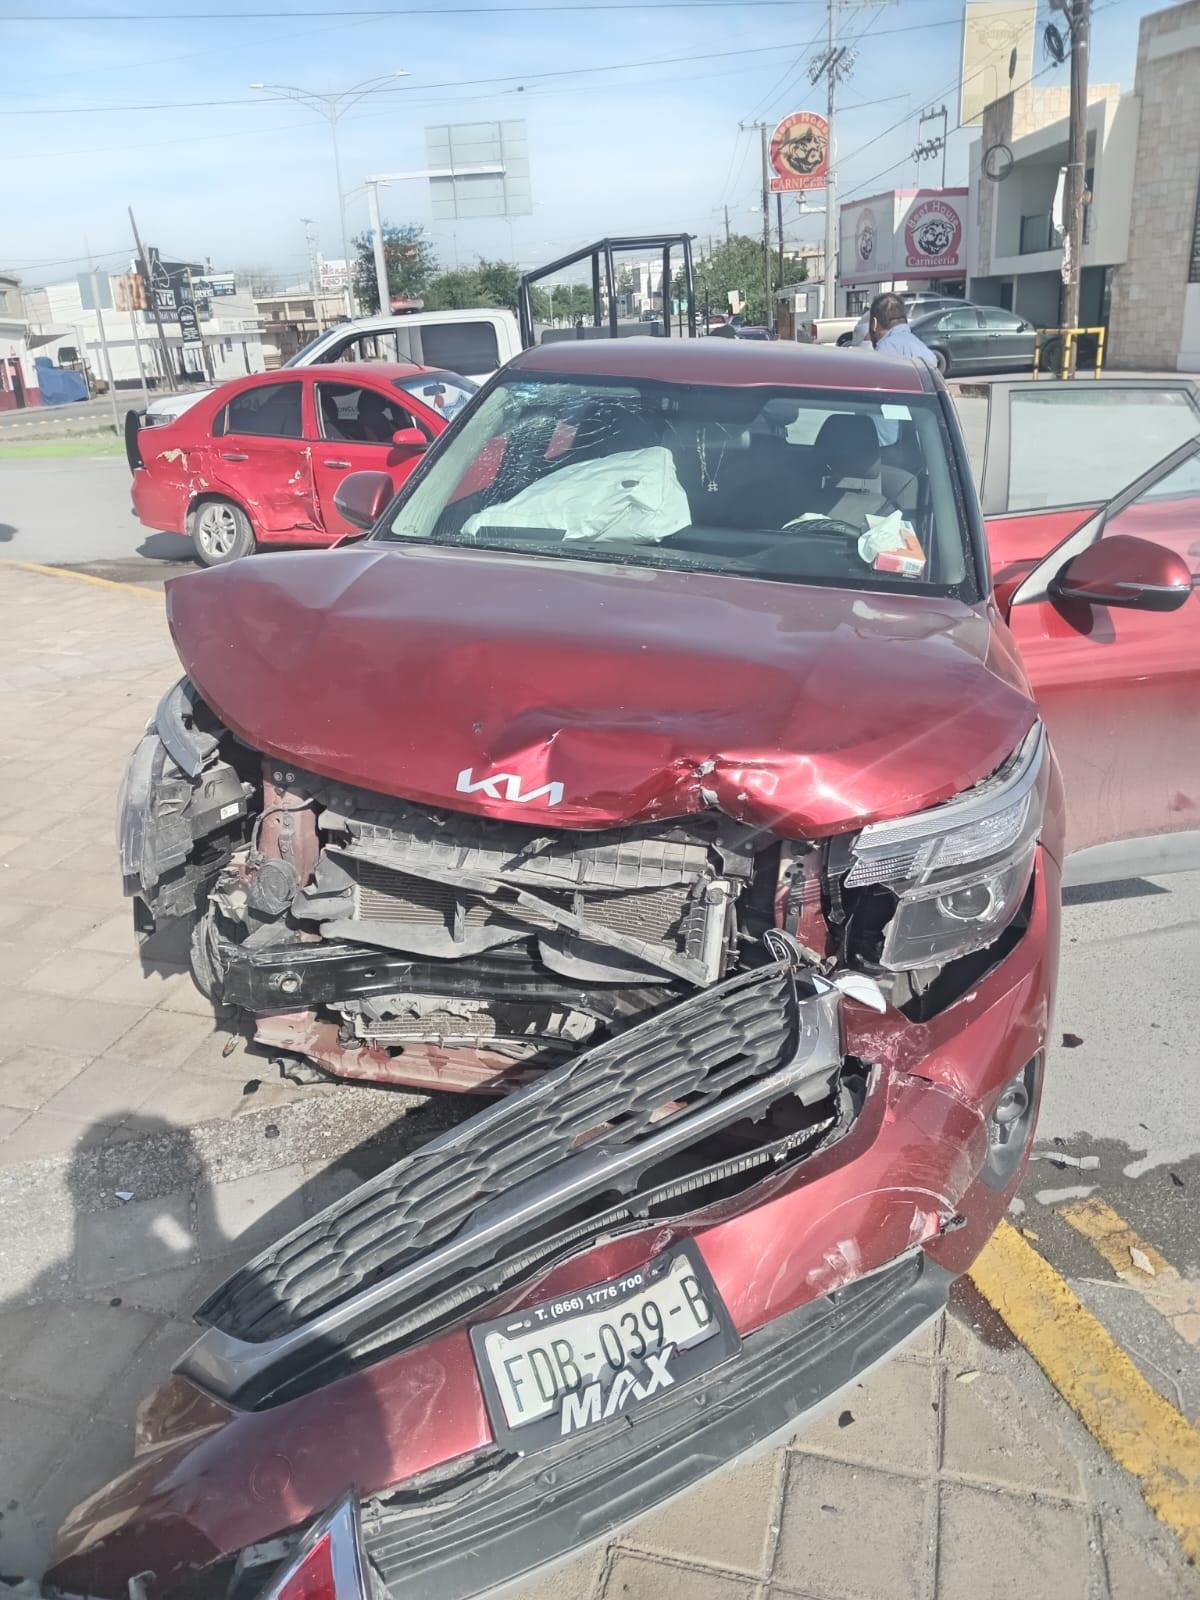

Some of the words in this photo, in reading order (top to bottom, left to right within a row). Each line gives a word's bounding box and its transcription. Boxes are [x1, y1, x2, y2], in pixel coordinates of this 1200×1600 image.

[775, 116, 798, 141] Beef
[801, 112, 828, 133] Hous
[907, 204, 929, 228] Beef
[932, 202, 960, 227] House
[456, 767, 564, 806] KIA
[534, 1308, 549, 1321] T.
[550, 1297, 584, 1319] (866)
[586, 1286, 618, 1305] 1776
[618, 1274, 643, 1292] 700
[503, 1275, 713, 1413] FDB-039-B
[560, 1345, 676, 1436] MAX
